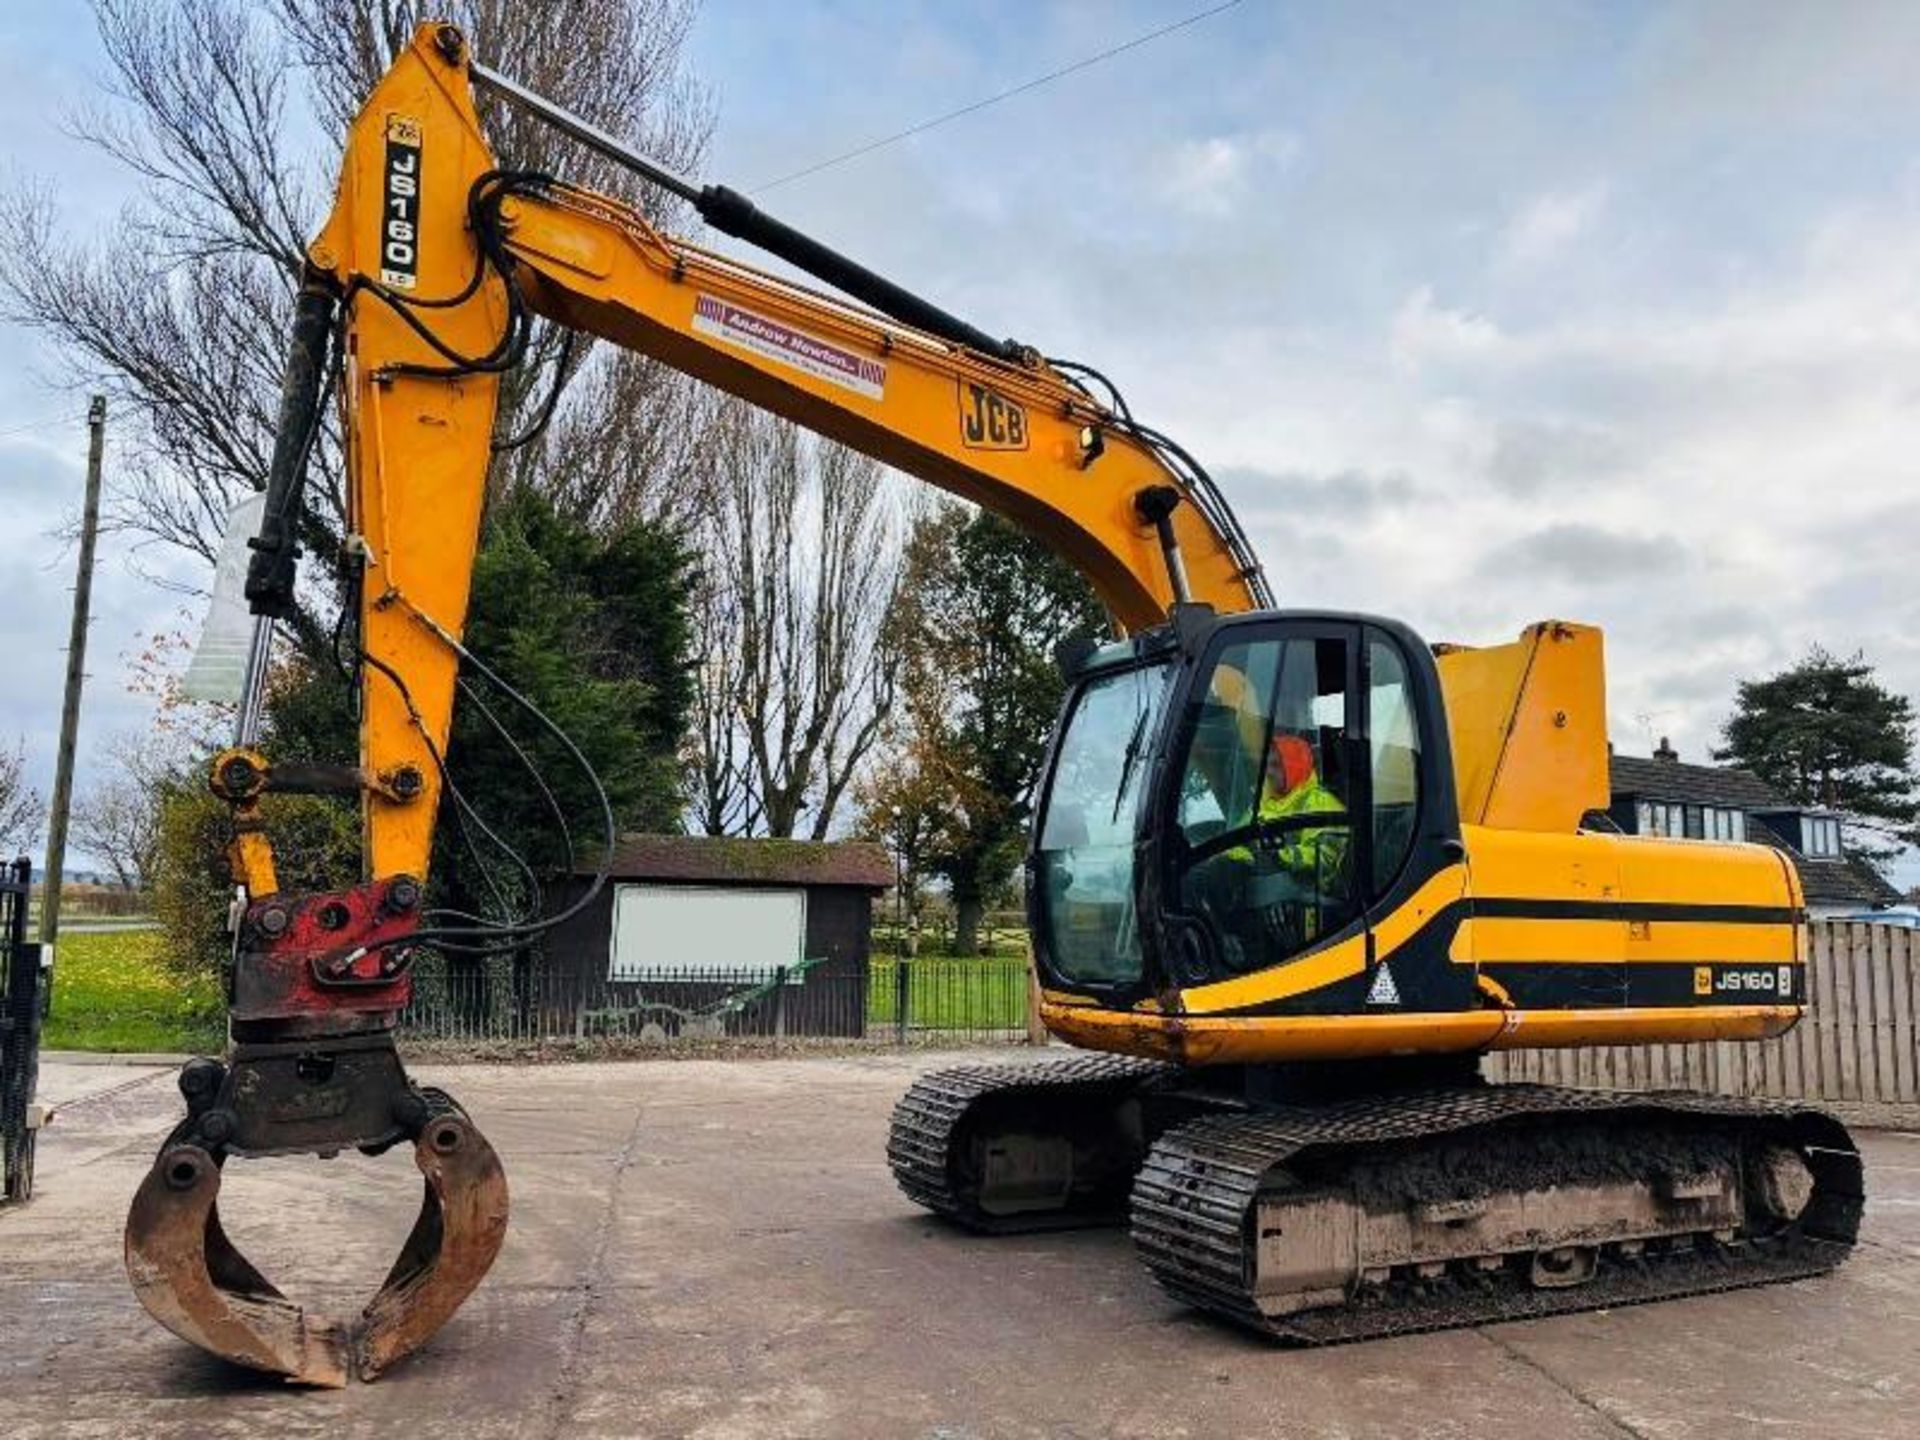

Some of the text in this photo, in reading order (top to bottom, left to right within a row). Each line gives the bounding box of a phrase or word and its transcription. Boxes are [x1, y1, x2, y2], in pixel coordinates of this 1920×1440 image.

[386, 155, 416, 265] JS160
[729, 313, 788, 344] Andrew
[967, 384, 1023, 444] JCB
[1715, 972, 1774, 990] JS160
